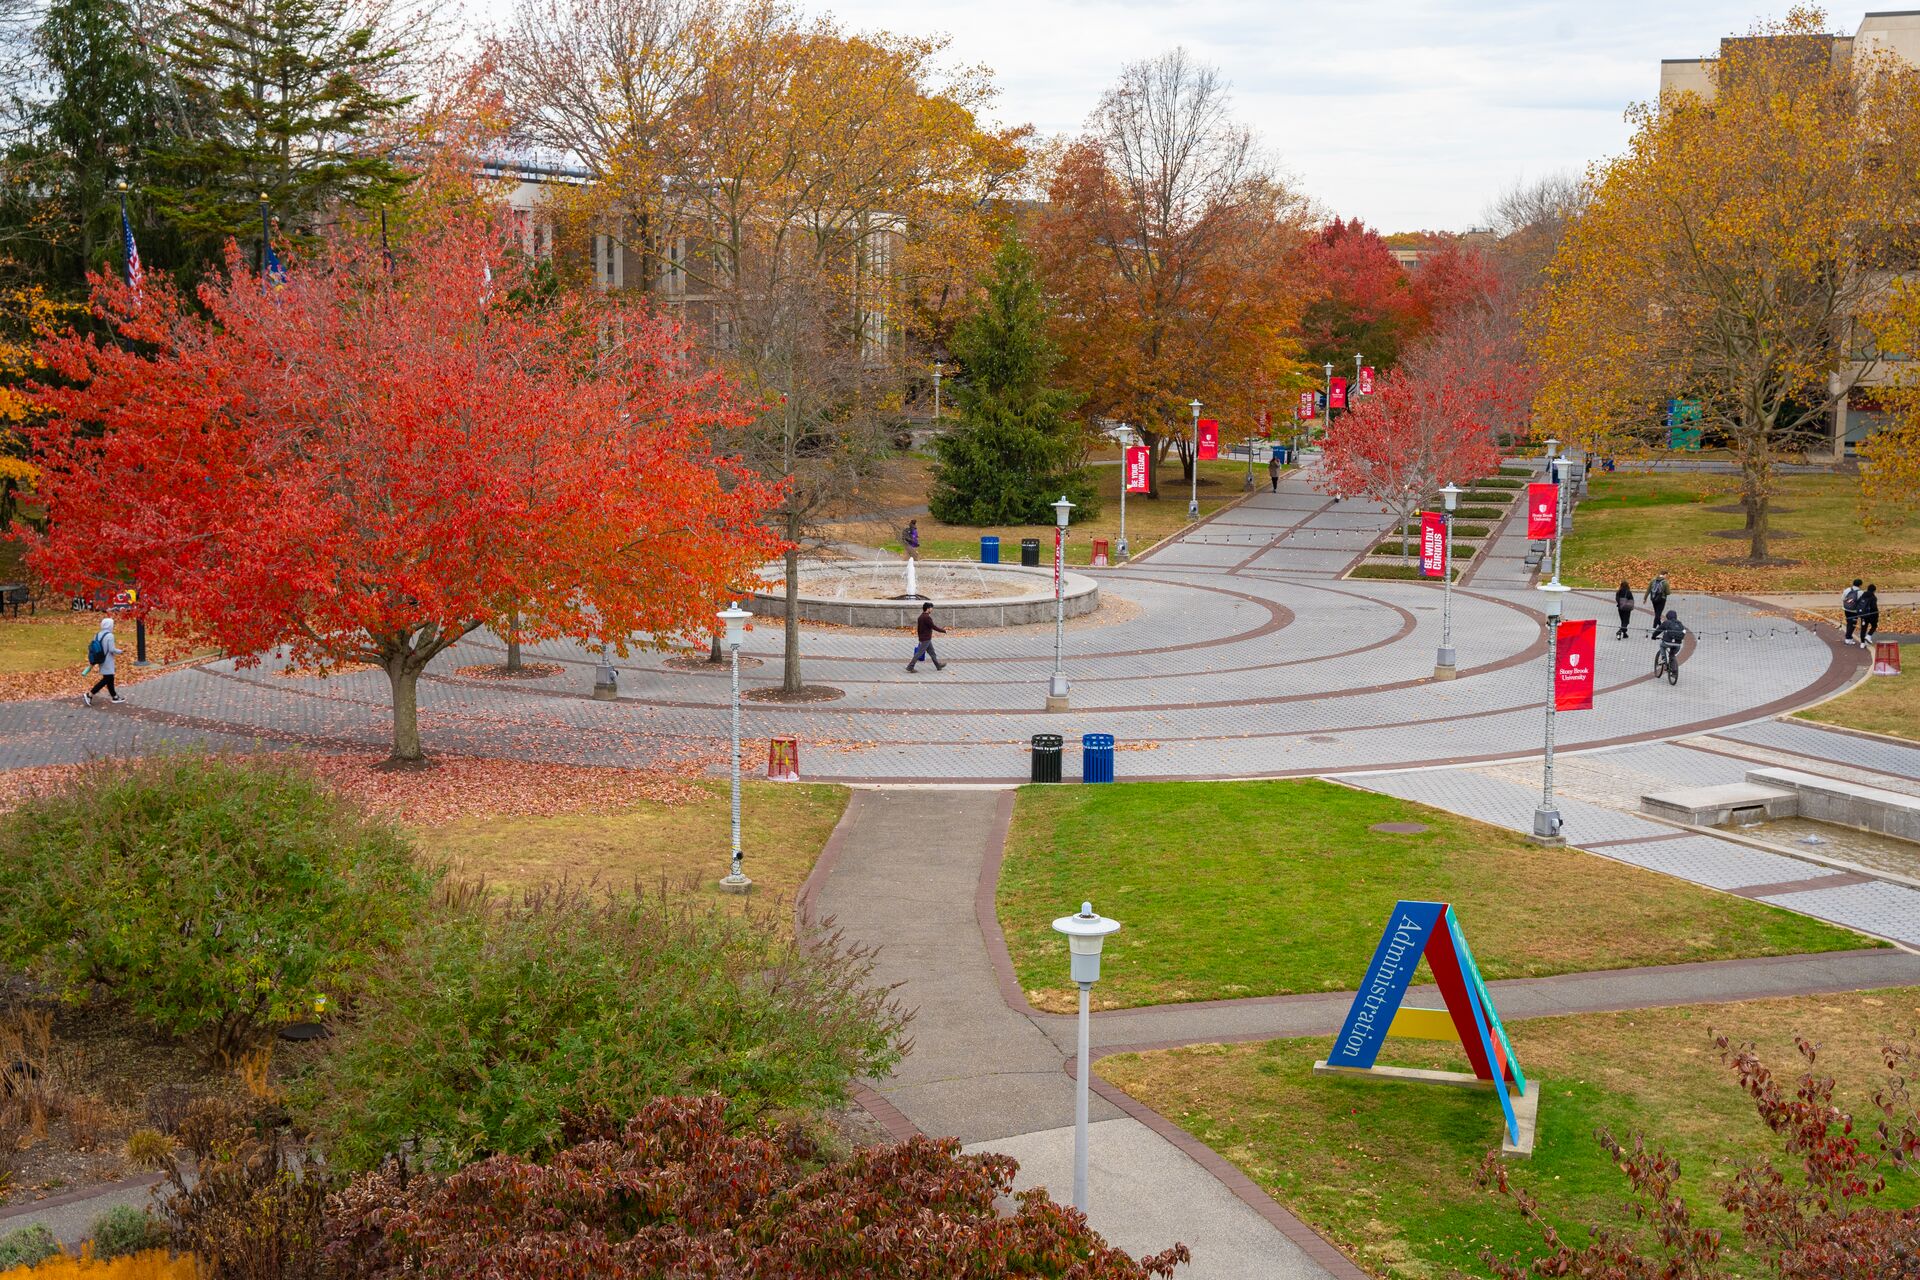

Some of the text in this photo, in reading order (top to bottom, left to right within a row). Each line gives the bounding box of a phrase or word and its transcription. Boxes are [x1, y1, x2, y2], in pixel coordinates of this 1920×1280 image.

[1424, 526, 1434, 569] BE WILDLY
[1433, 533, 1443, 570] CURIOUS
[1342, 914, 1423, 1057] Administration
